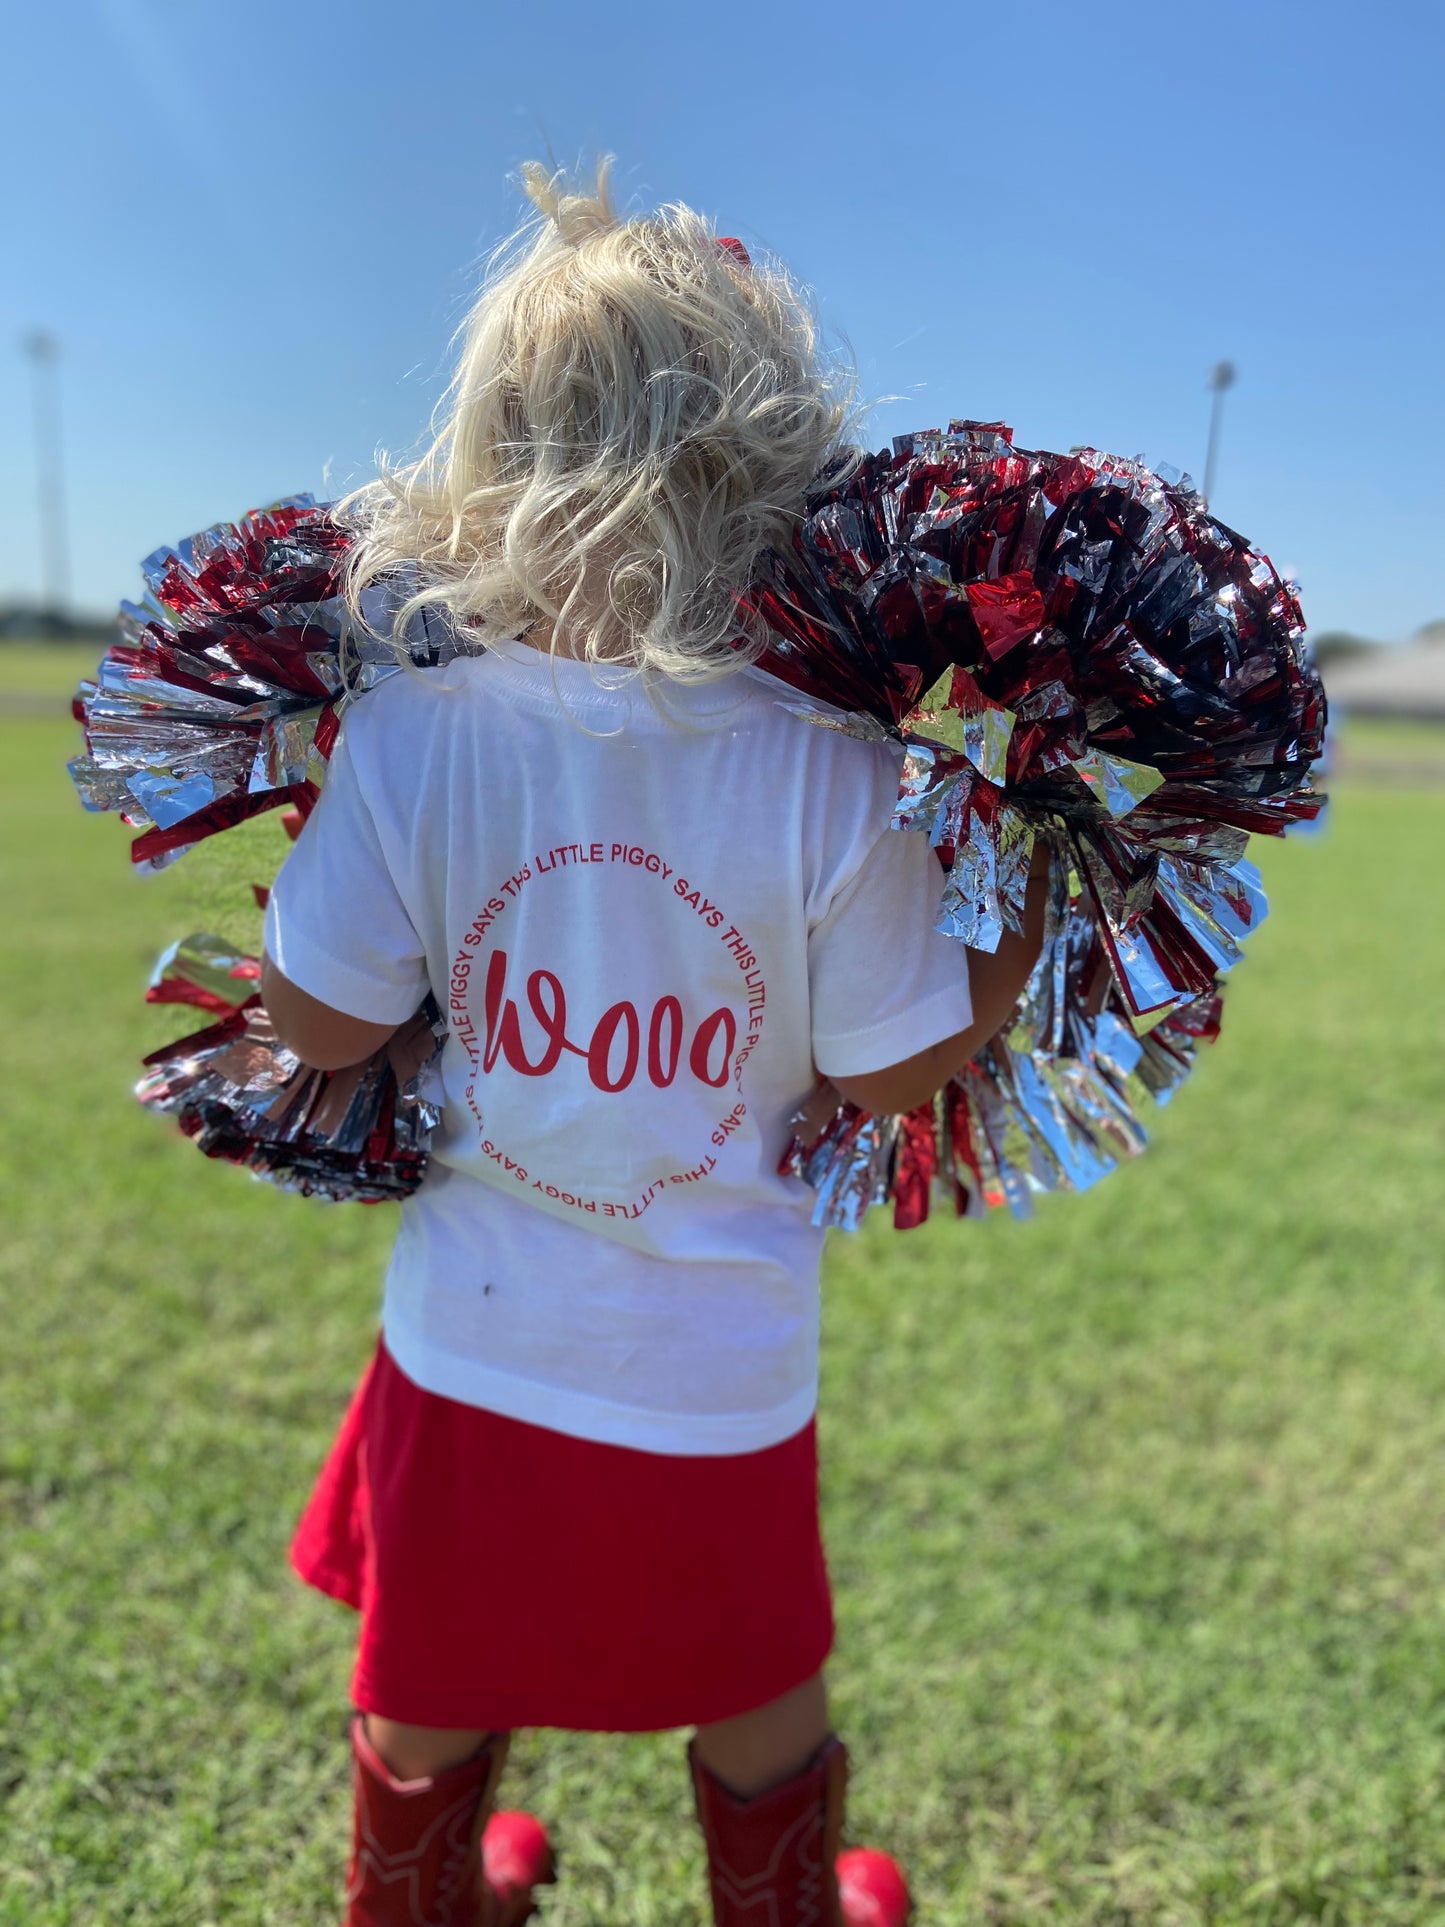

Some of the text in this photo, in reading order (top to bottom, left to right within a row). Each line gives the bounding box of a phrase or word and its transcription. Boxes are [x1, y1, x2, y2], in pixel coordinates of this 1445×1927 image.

[535, 843, 604, 873] LITTLE
[611, 843, 673, 880] PIGGY
[463, 897, 506, 947] SAYS
[673, 878, 725, 928] SAYS
[721, 925, 757, 971] THIS
[450, 949, 475, 1011] PIGGY
[745, 969, 766, 1032] LITTLE
[483, 949, 737, 1093] Wooo
[452, 1014, 480, 1078] LITTLE
[711, 1103, 747, 1147] SAYS
[481, 1140, 529, 1182] SAYS
[669, 1155, 717, 1184] THIS
[532, 1180, 597, 1213] PIGGY
[601, 1179, 665, 1219] LITTLE
